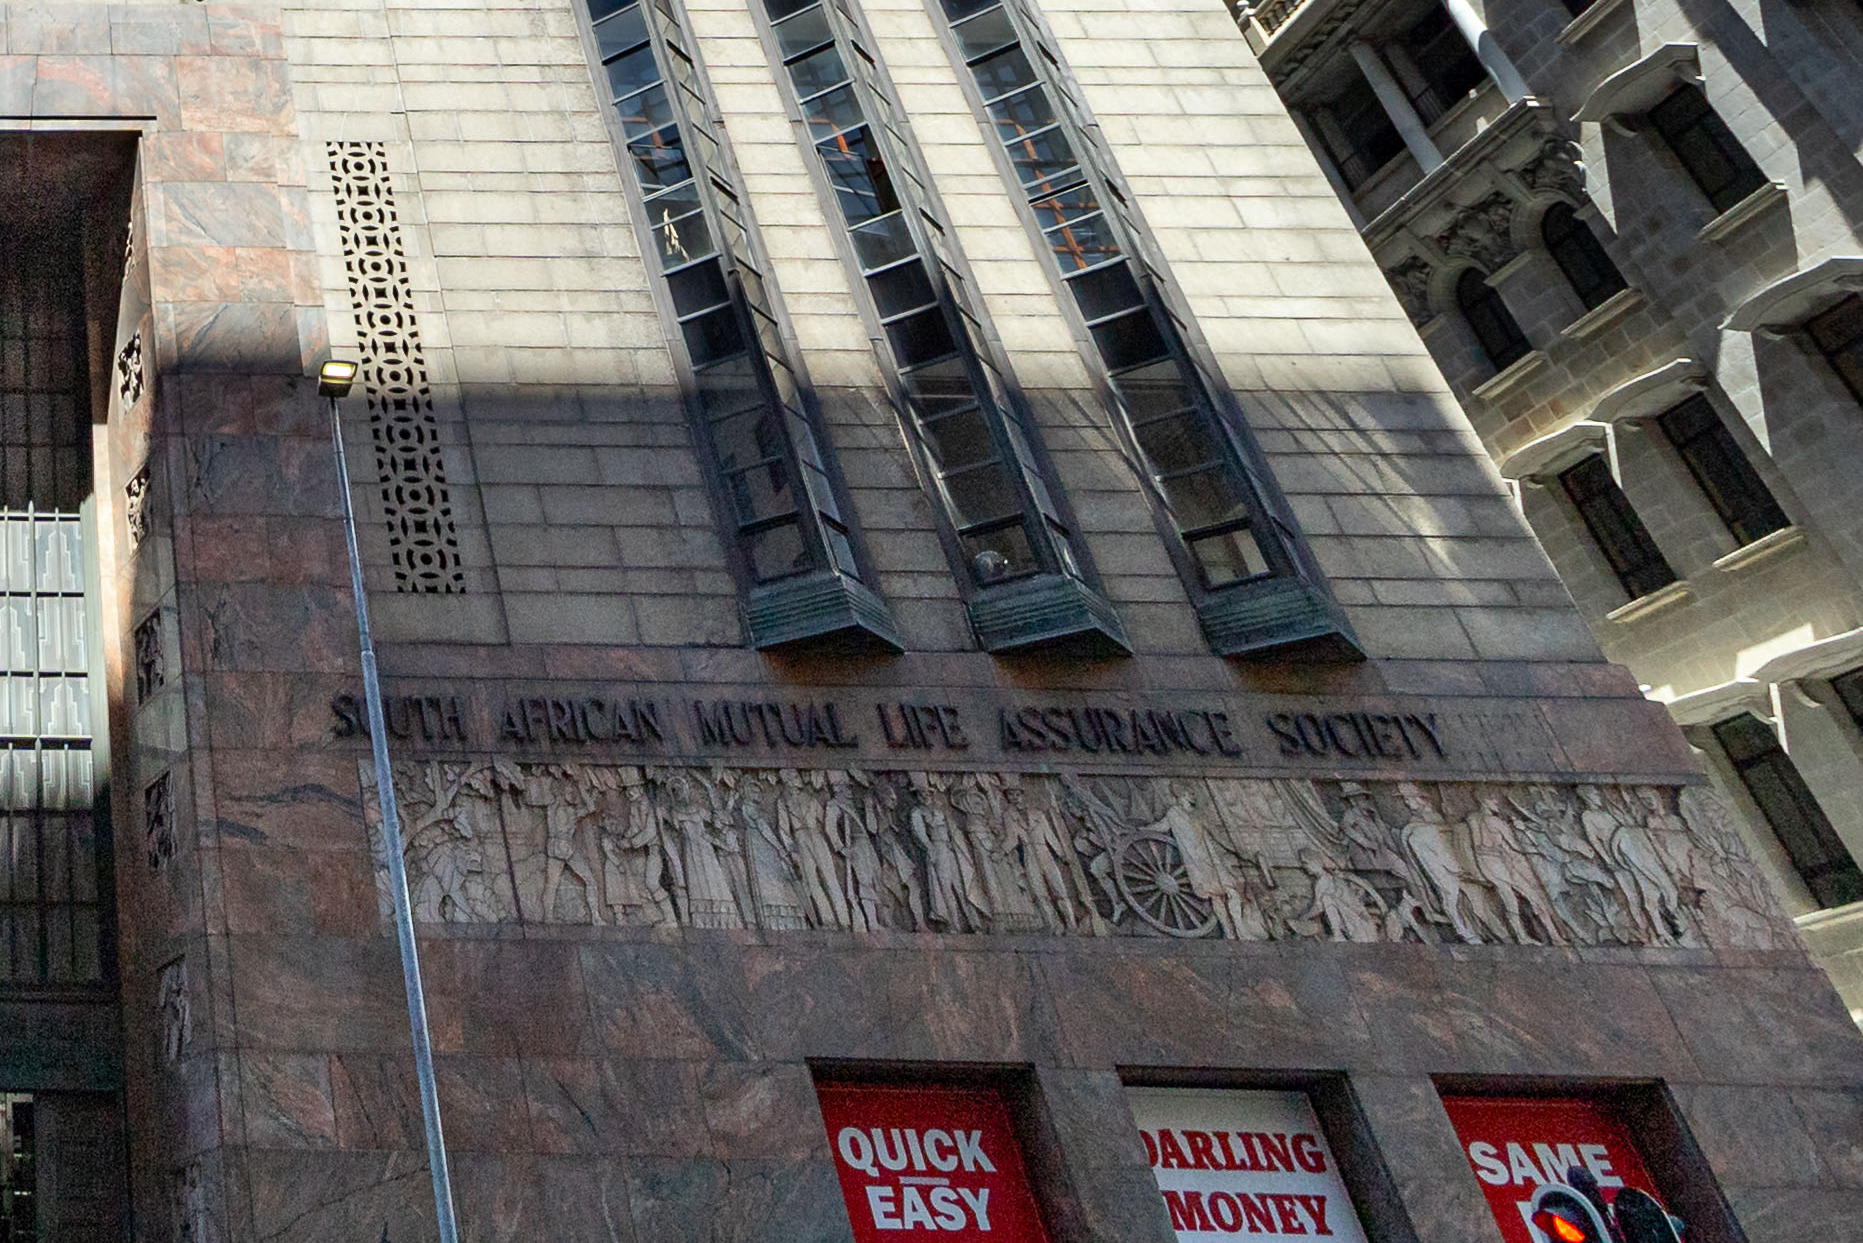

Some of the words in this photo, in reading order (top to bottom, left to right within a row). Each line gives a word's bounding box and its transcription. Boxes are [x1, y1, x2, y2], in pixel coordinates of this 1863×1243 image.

[497, 697, 665, 746] AFRICAN
[693, 699, 860, 750] MUTUAL
[876, 702, 971, 752] LIFE
[999, 705, 1241, 757] ASSURANCE
[1267, 710, 1450, 760] SOCIETY
[838, 1127, 998, 1177] QUICK
[1469, 1141, 1624, 1187] SAME
[866, 1185, 992, 1232] EASY
[1161, 1190, 1334, 1236] MONEY
